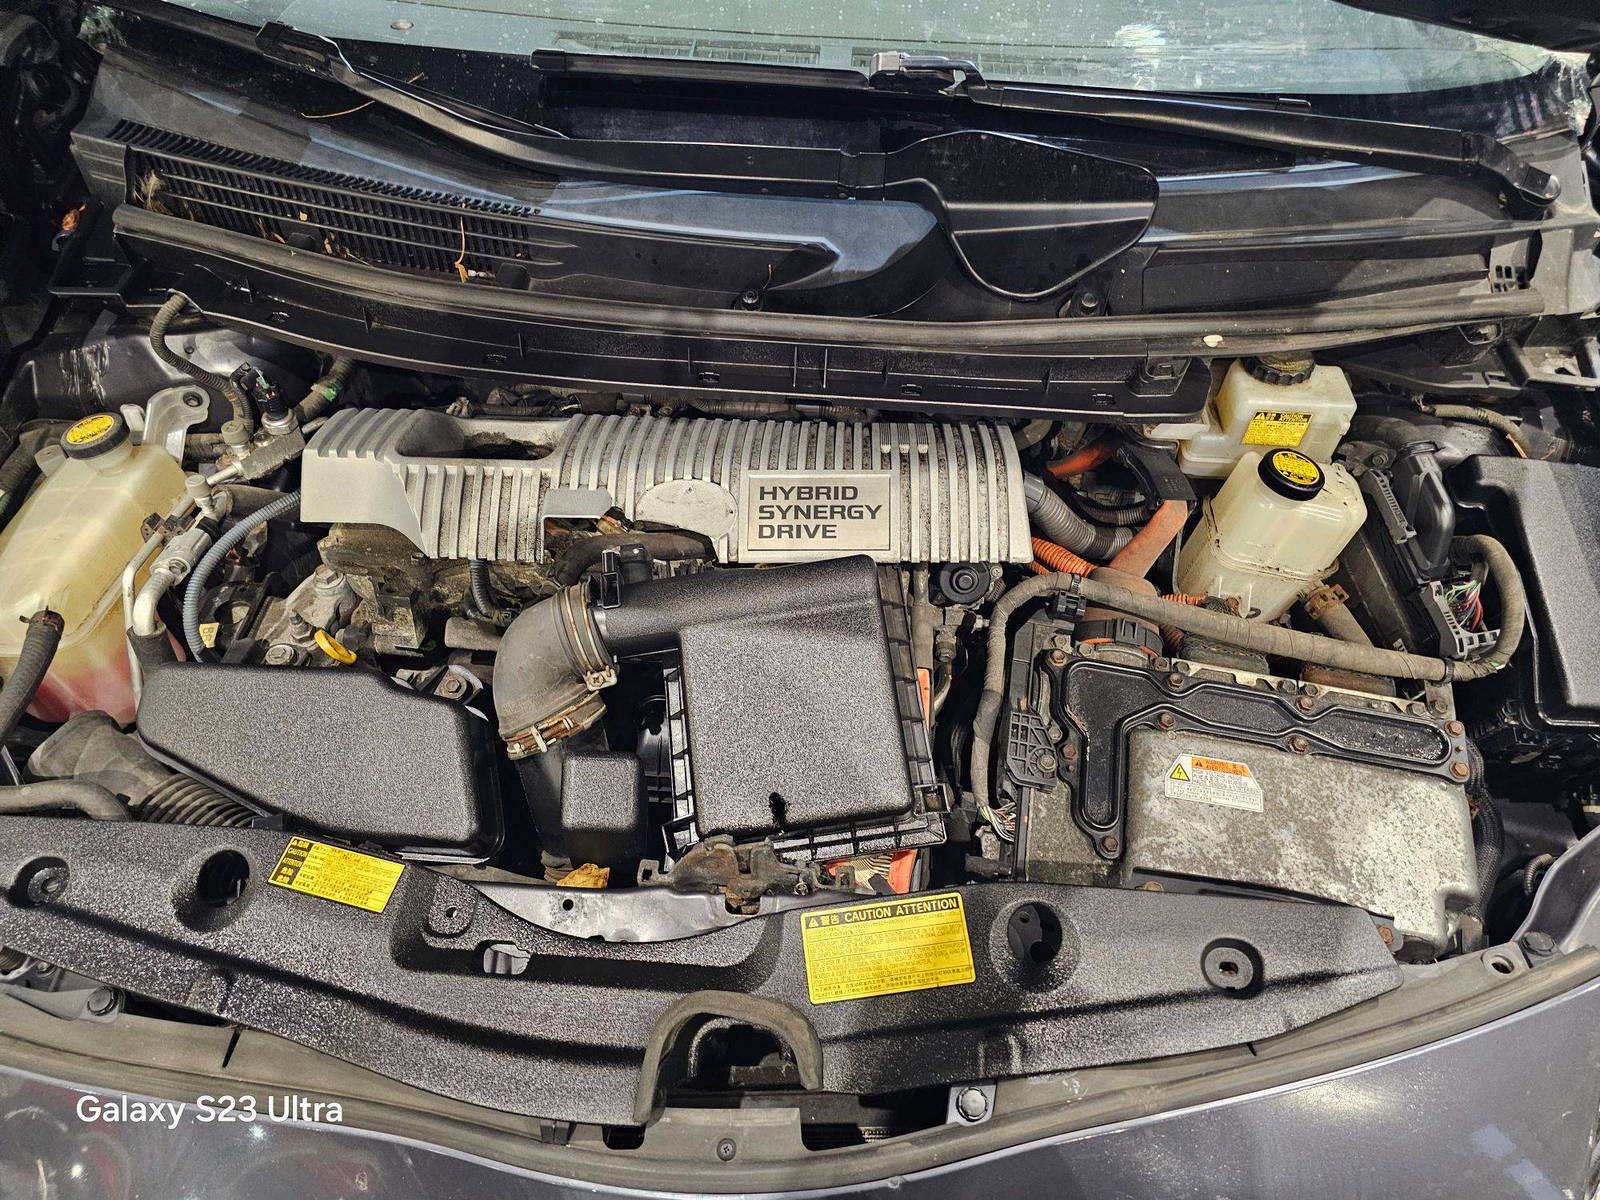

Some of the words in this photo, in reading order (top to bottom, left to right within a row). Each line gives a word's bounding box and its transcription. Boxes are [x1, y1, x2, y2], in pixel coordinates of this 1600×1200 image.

[759, 486, 858, 501] HYBRID
[758, 504, 882, 520] SYNERGY
[758, 524, 837, 539] DRIVE
[844, 906, 892, 923] CAUTION
[896, 898, 957, 916] ATTENTION
